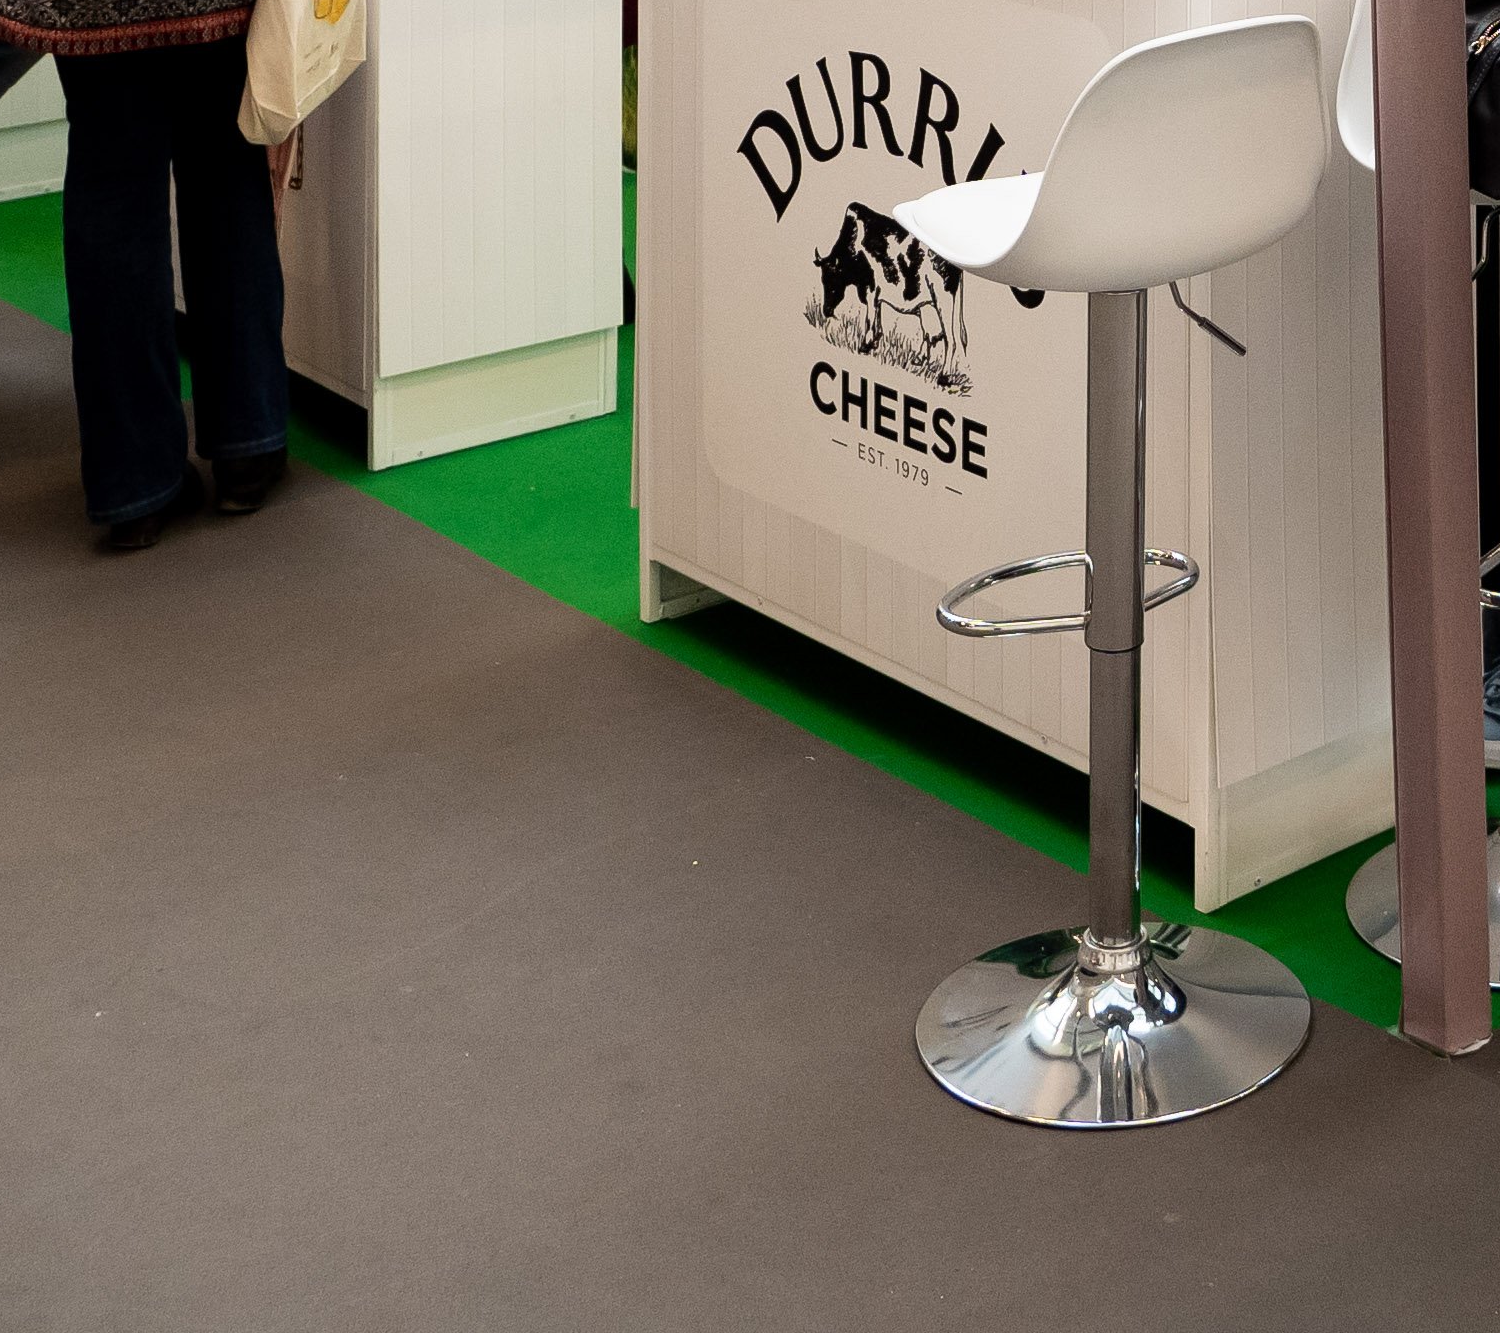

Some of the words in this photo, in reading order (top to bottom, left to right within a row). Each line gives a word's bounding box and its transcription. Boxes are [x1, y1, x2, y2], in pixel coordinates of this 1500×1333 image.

[736, 50, 1032, 225] DURR
[810, 361, 988, 480] CHEESE
[858, 443, 889, 473] EST.
[894, 458, 930, 487] 1979
